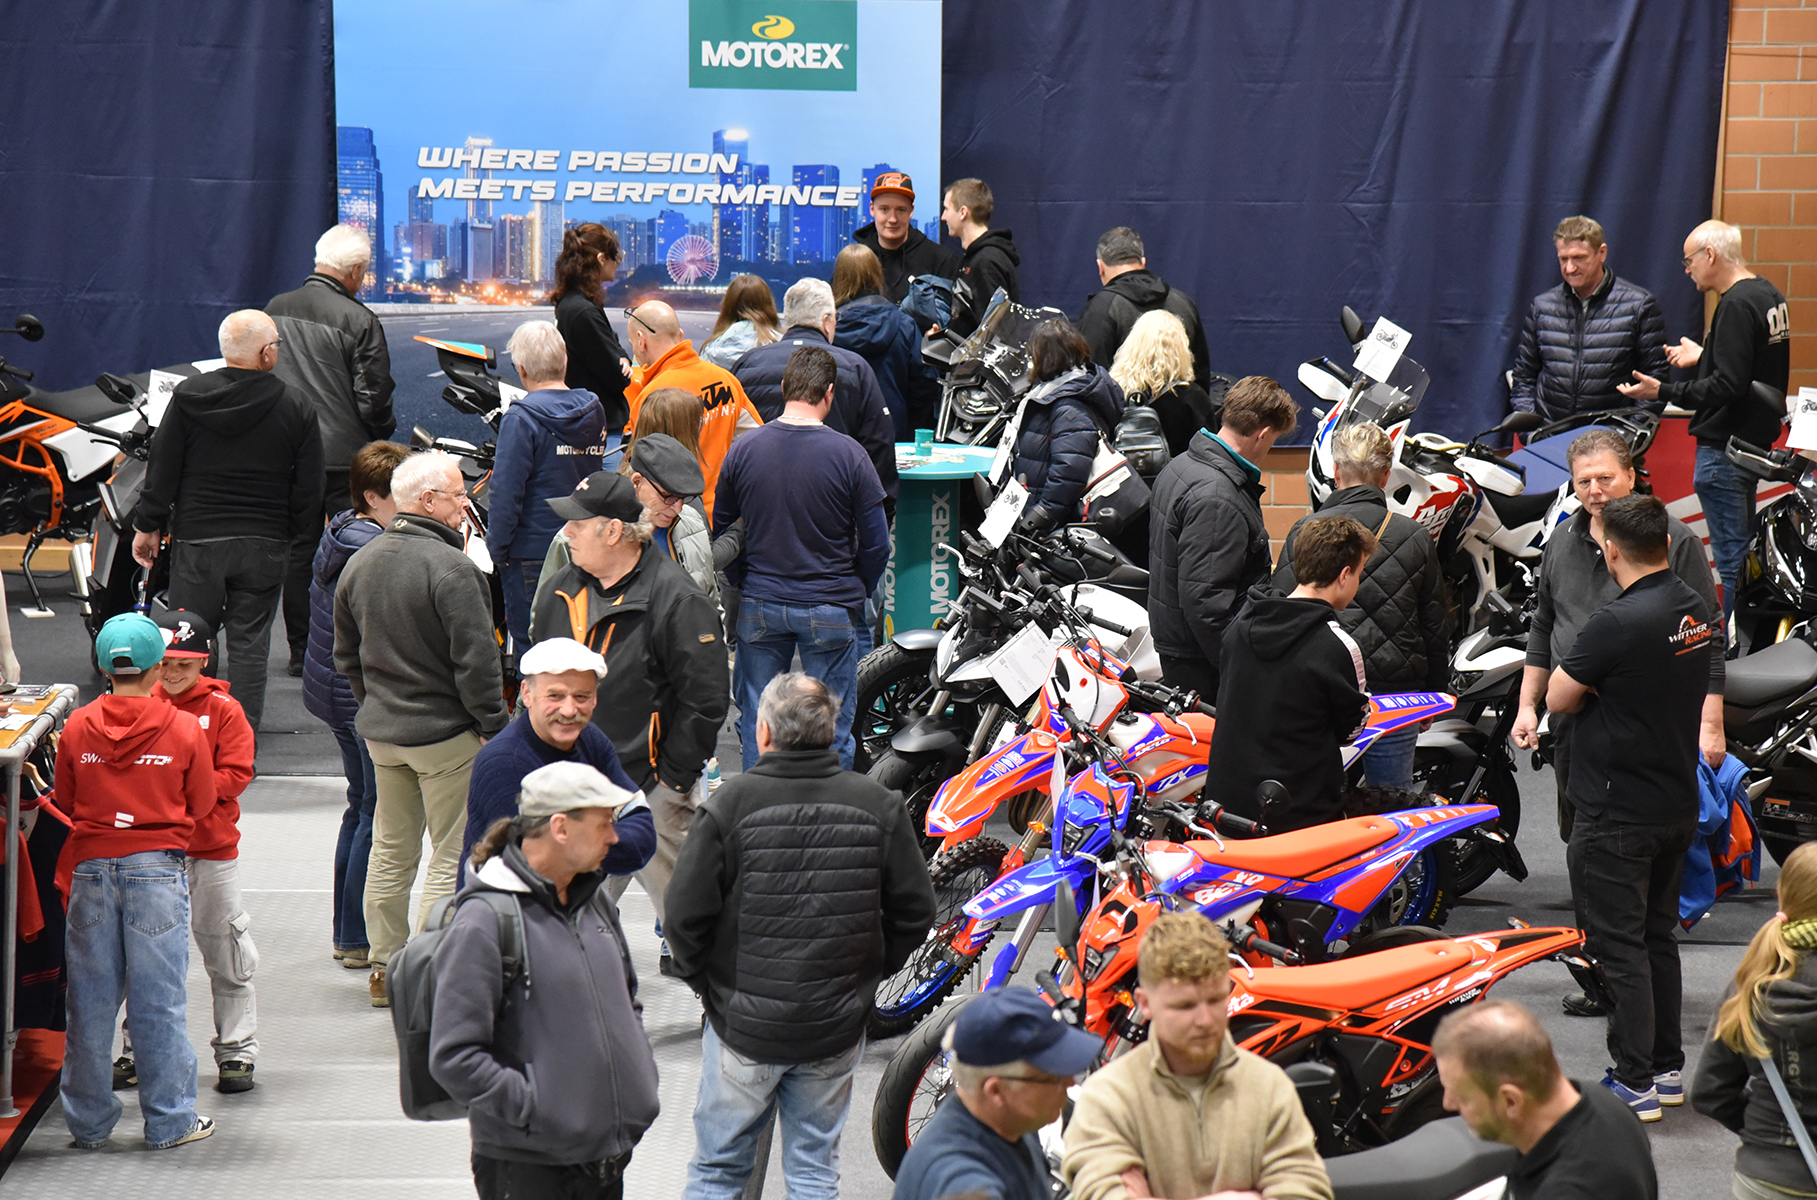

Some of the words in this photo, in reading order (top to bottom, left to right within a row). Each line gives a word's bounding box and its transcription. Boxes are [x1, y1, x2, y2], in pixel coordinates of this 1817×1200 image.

[701, 40, 844, 69] MOTOREX
[417, 147, 560, 170] WHERE
[567, 150, 739, 174] PASSION
[417, 177, 557, 200] MEETS
[564, 180, 862, 206] PERFORMANCE
[701, 381, 735, 411] KTM
[930, 491, 950, 614] MOTOREX
[1668, 623, 1707, 643] WITTWER
[1685, 628, 1712, 645] RACING
[1194, 871, 1265, 905] Beta
